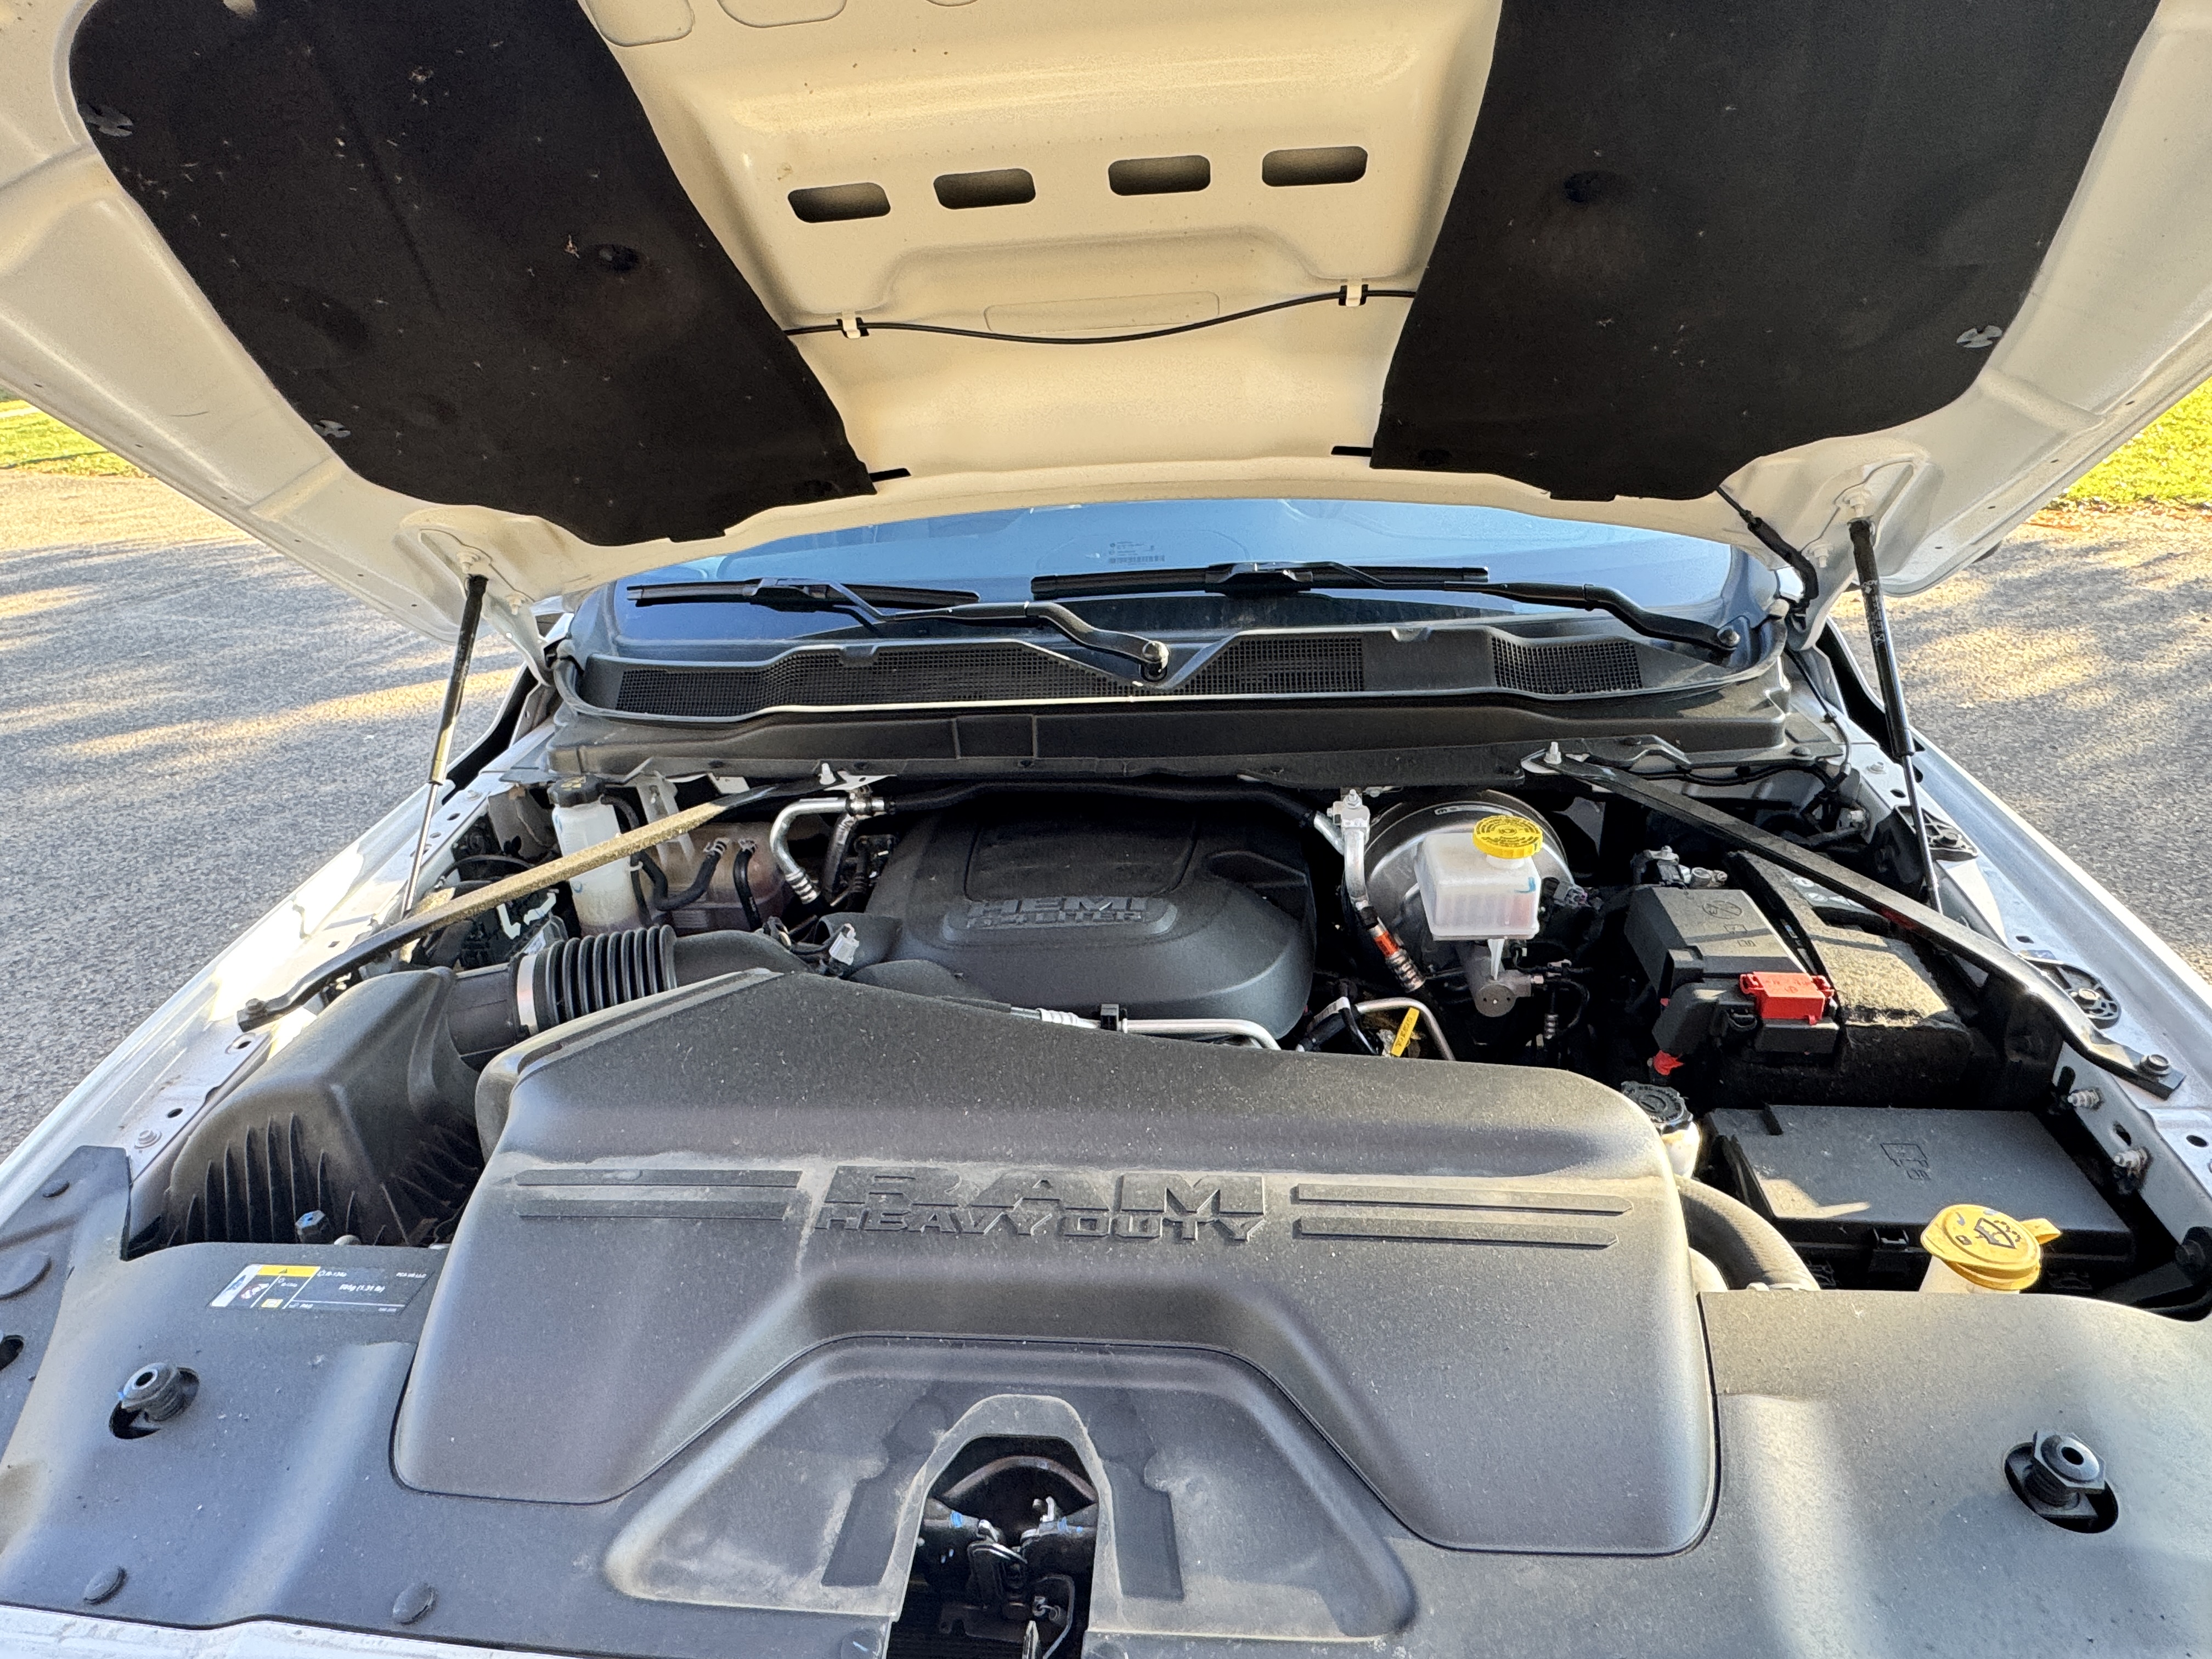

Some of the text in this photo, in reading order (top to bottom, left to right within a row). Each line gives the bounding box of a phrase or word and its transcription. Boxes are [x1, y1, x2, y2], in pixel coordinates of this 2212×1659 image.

[967, 896, 1148, 918] HEMI
[824, 1165, 1265, 1215] RAM
[814, 1208, 1266, 1242] HEAVY DUTY
